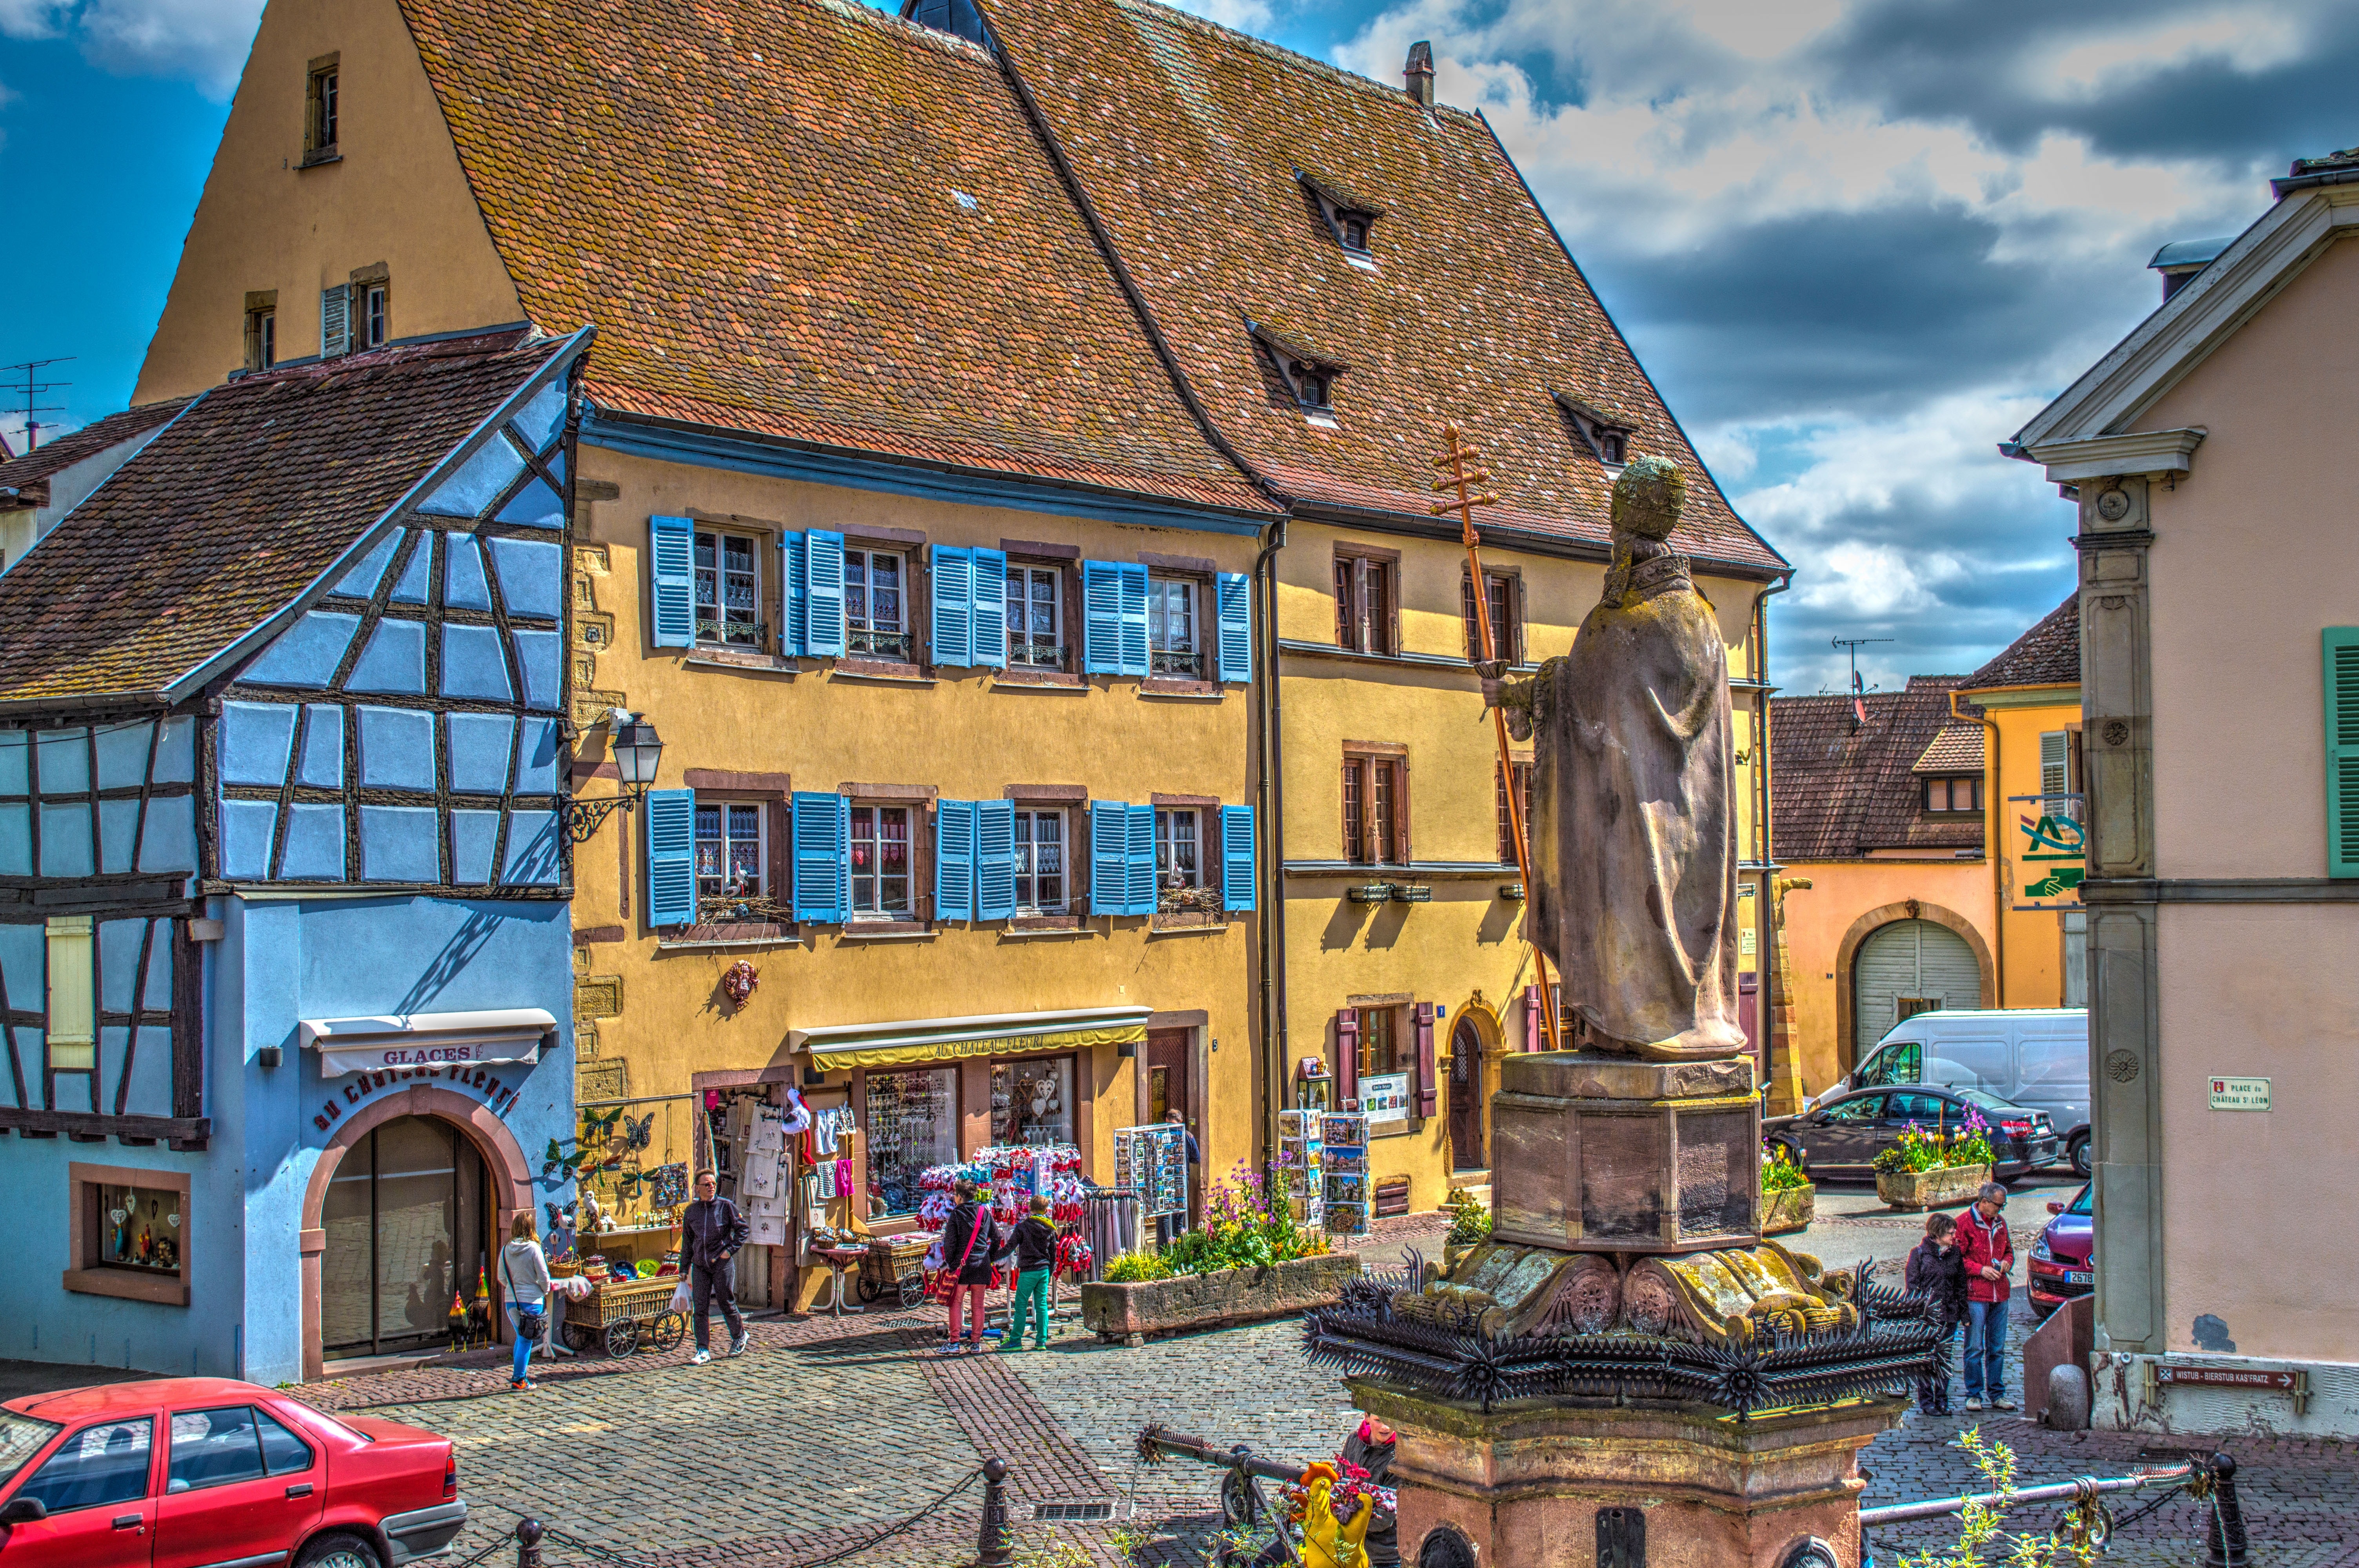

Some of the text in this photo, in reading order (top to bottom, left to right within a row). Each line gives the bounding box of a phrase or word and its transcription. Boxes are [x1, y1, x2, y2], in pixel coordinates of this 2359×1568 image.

[934, 1035, 1044, 1057] AU CHATEAU FLEURI
[1213, 1040, 1218, 1049] 5
[383, 1046, 470, 1065] GLACES
[2212, 1094, 2240, 1103] CHÂTEAU
[2072, 1273, 2092, 1283] 2678
[2176, 1370, 2199, 1379] WISTUB
[2205, 1372, 2234, 1381] BIERSTUB
[2235, 1374, 2268, 1383] KAS'FRATZ
